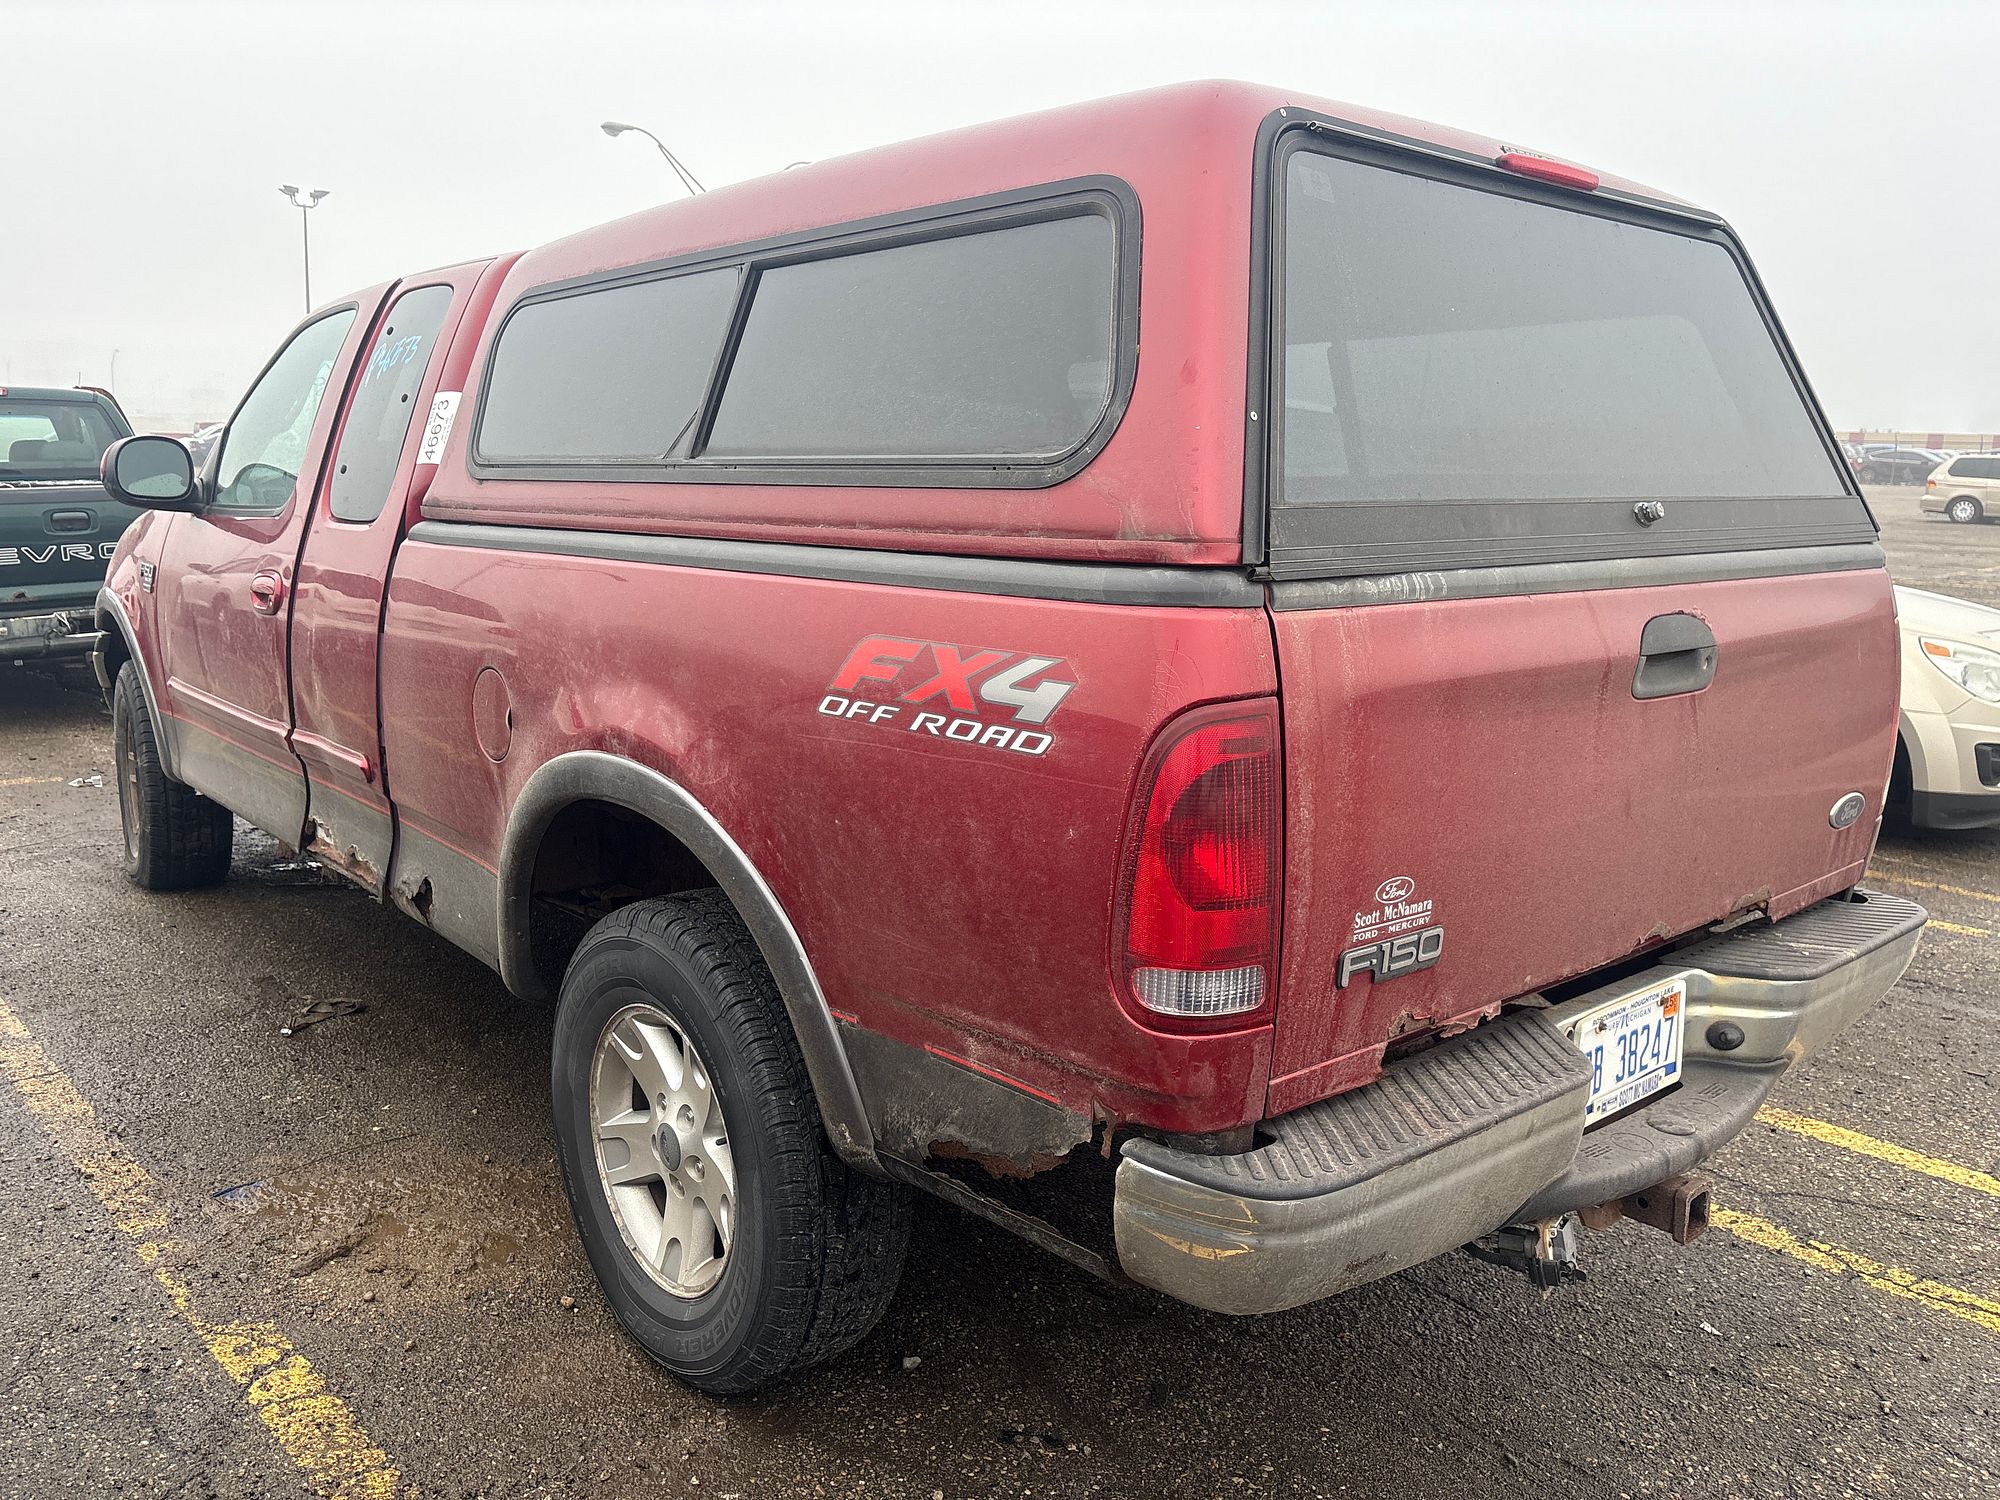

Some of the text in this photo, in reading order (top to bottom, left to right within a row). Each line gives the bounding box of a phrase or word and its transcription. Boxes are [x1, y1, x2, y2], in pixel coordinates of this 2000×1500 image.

[424, 399, 449, 460] 46673
[829, 634, 1080, 726] FX4
[818, 695, 1055, 756] OFF ROAD
[1381, 879, 1409, 900] Ford
[1353, 929, 1378, 942] FORD
[1388, 916, 1431, 933] MERCURY
[1354, 899, 1433, 929] Scott McNamara
[1630, 993, 1659, 1009] HOUGHTON
[1660, 985, 1675, 997] LAKE
[1586, 1016, 1675, 1096] B 38247
